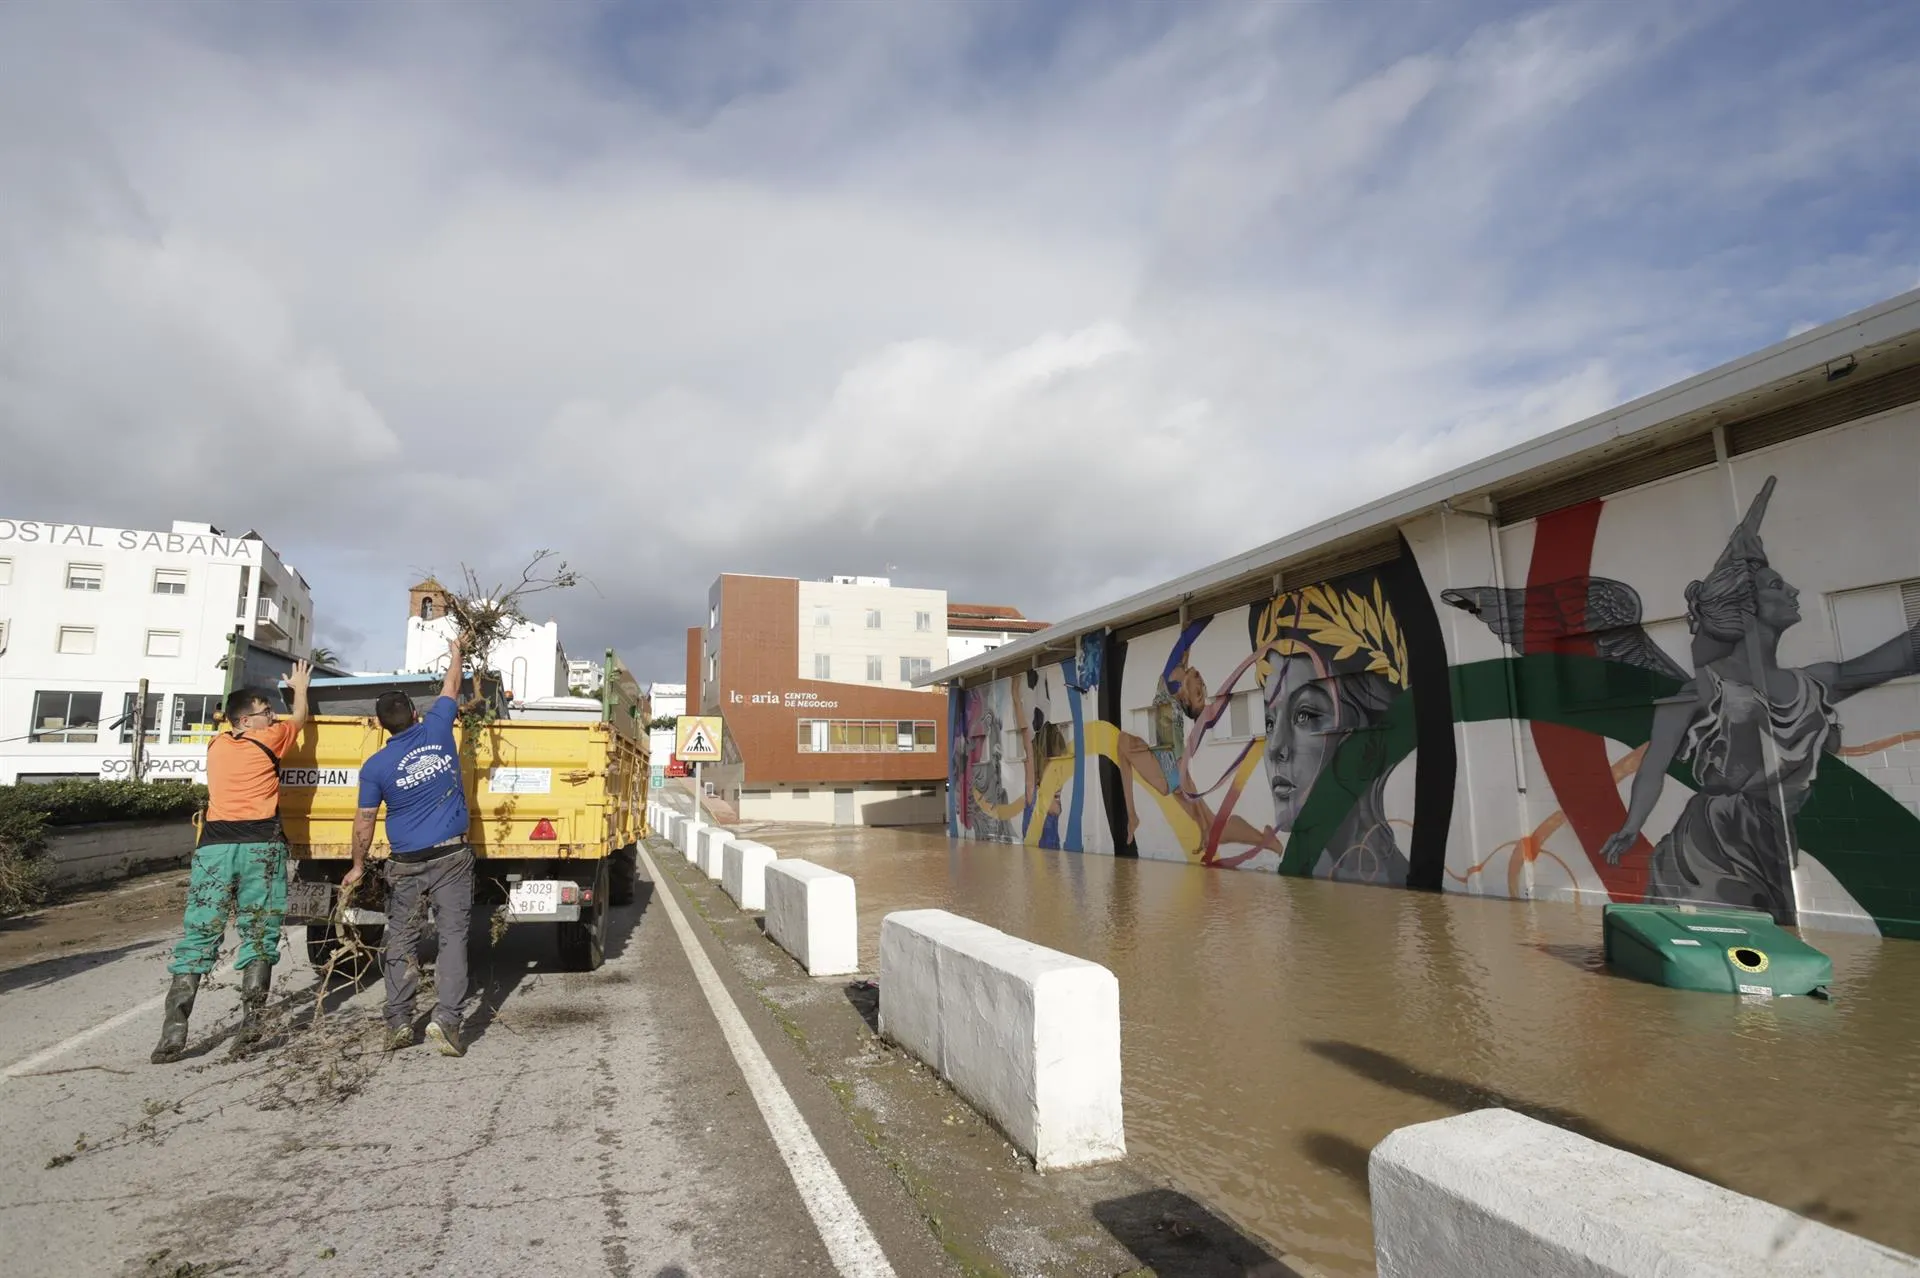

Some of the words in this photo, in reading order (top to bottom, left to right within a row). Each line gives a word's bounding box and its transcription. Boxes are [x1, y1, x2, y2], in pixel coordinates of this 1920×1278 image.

[0, 519, 104, 547] OSTAL
[117, 530, 252, 558] SABANA
[784, 692, 818, 700] CENTRO
[784, 700, 796, 708] DE
[797, 700, 839, 708] NEGOCIOS
[279, 769, 348, 785] MERCHAN
[396, 754, 452, 787] SEGOVIA
[516, 882, 523, 894] E
[526, 883, 552, 895] 3029
